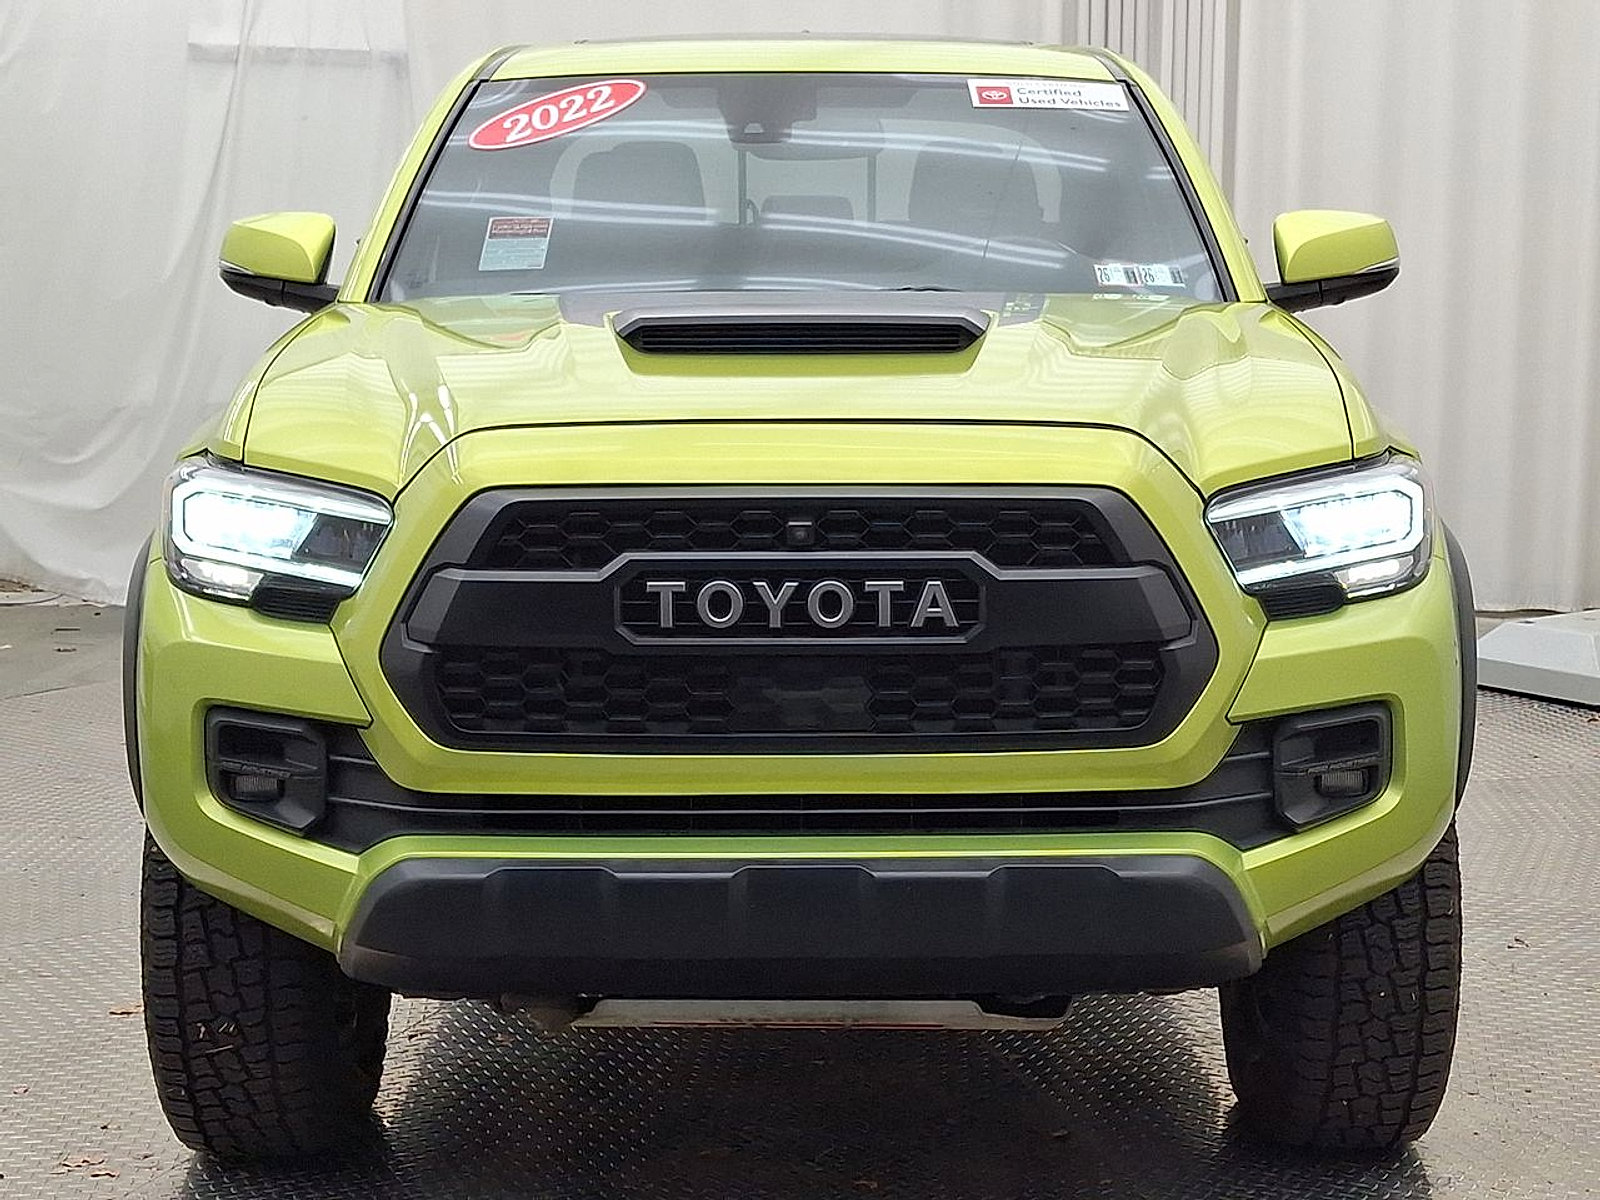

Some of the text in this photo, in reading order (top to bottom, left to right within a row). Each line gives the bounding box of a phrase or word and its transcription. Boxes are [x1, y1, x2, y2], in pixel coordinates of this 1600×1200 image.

[1017, 86, 1081, 97] Certified
[1019, 96, 1121, 107] Used Vehicles
[503, 85, 615, 142] 2022
[646, 580, 959, 629] TOYOTA
